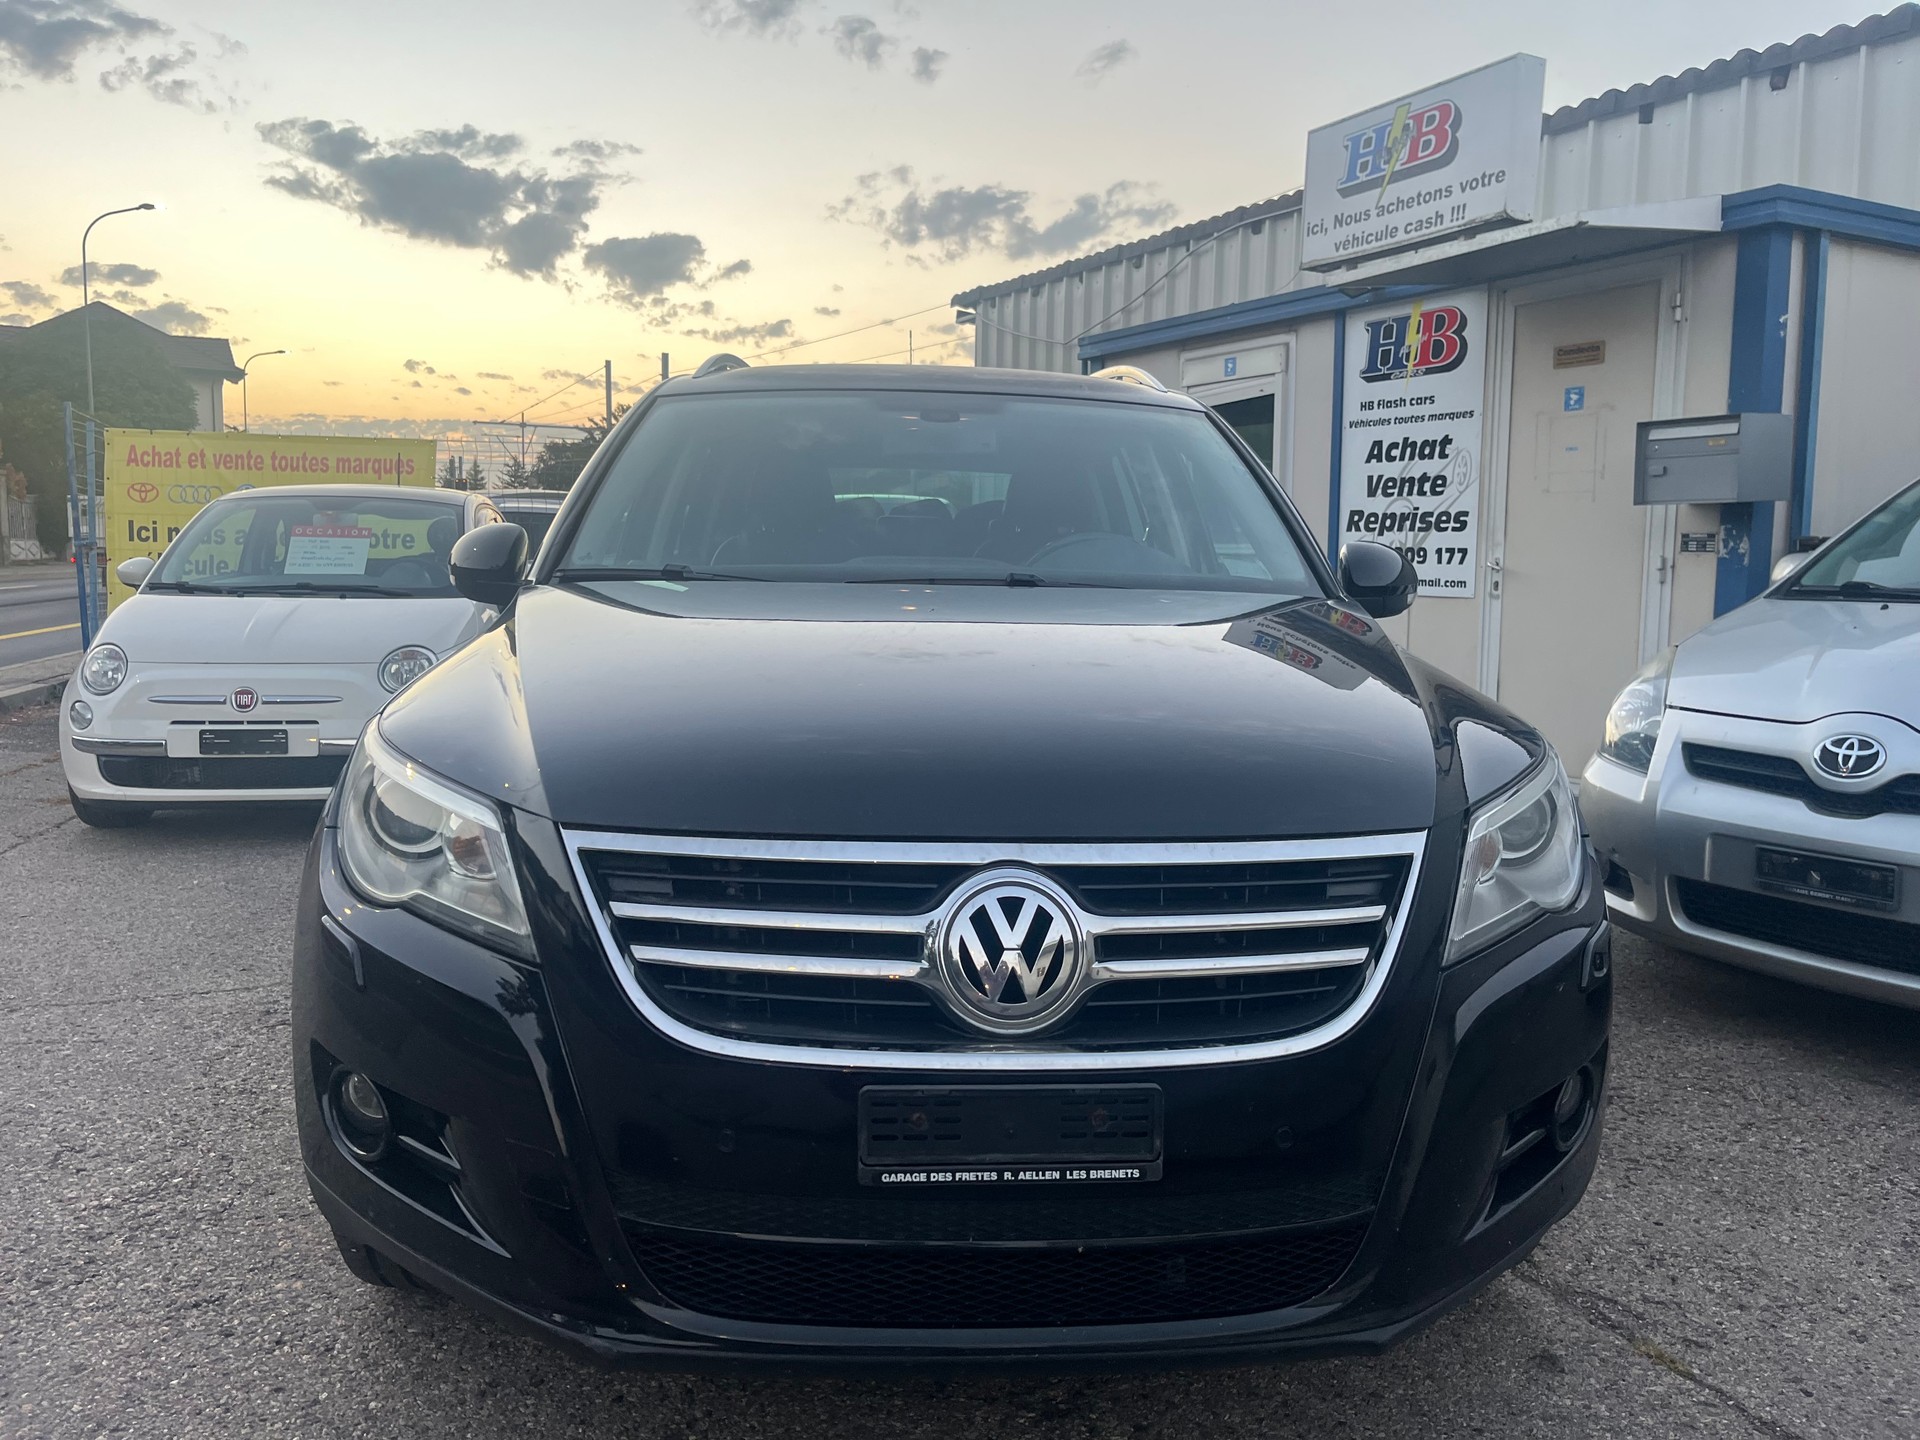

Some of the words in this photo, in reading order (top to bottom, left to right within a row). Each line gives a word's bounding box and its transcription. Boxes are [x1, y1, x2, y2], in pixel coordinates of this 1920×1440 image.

[1337, 99, 1462, 199] HB
[1306, 218, 1328, 238] ici,
[1333, 208, 1371, 230] Nous
[1376, 183, 1453, 218] achetons
[1459, 169, 1506, 195] votre
[1334, 221, 1398, 253] véhicule
[1403, 210, 1444, 236] cash
[1450, 203, 1467, 223] !!!
[1359, 305, 1468, 384] HB
[1360, 401, 1374, 411] HB
[1377, 397, 1407, 410] flash
[1409, 395, 1435, 407] cars
[1349, 415, 1391, 429] Véhicules
[1394, 413, 1425, 425] toutes
[1428, 410, 1475, 422] marques
[126, 444, 182, 469] Achat
[187, 447, 207, 470] et
[212, 449, 265, 471] vente
[270, 450, 330, 473] toutes
[335, 455, 415, 481] marques
[1365, 434, 1453, 464] Achat
[1366, 472, 1448, 498] Vente
[128, 519, 158, 543] Ici
[369, 528, 416, 550] otre
[296, 527, 369, 536] OCCASION
[1346, 507, 1470, 536] Reprises
[1435, 548, 1468, 565] 177
[1417, 578, 1467, 589] mail.com
[237, 694, 252, 706] FIAT
[881, 1172, 927, 1183] GARAGE
[930, 1172, 952, 1182] DES
[955, 1171, 998, 1182] FRETES
[1004, 1171, 1015, 1181] R.
[1018, 1170, 1060, 1181] AELLEN
[1066, 1170, 1087, 1180] LES
[1089, 1169, 1140, 1179] BRENETS
